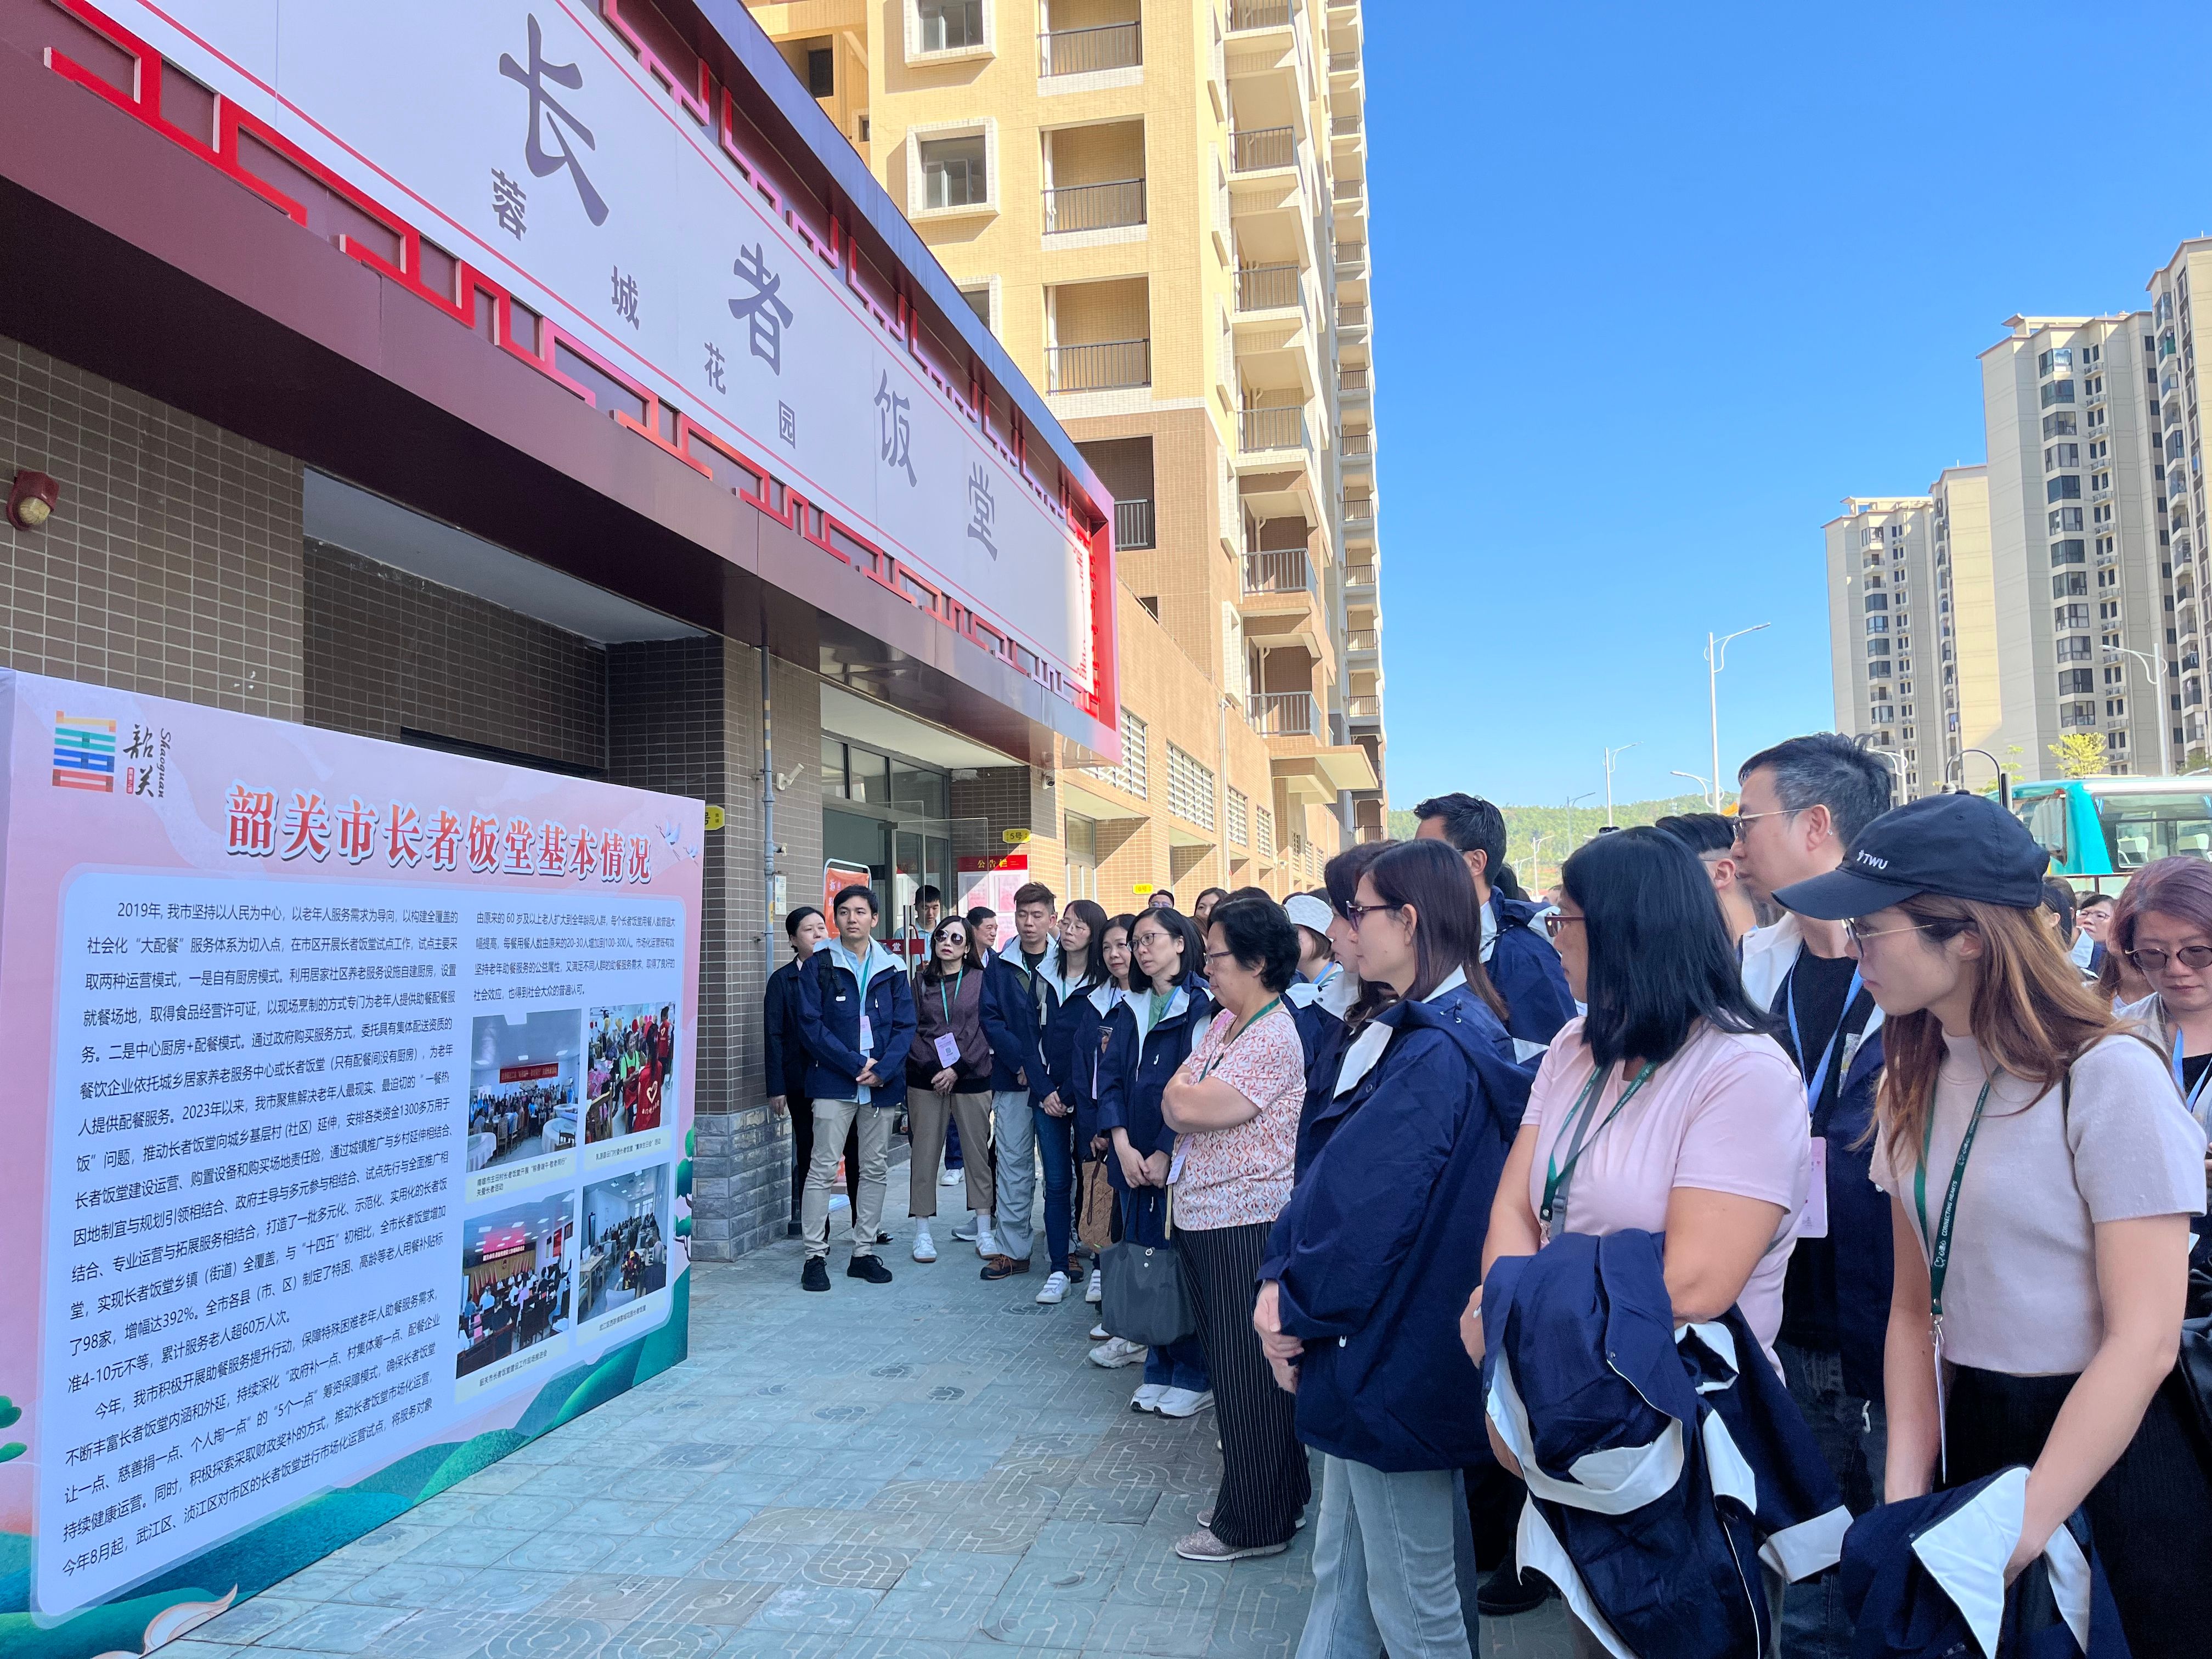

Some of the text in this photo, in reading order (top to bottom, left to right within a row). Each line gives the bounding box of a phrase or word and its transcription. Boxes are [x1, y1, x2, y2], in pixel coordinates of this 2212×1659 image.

[490, 167, 796, 449] 蓉城花园
[499, 13, 998, 562] 长者饭堂
[156, 727, 171, 798] Shaoguan
[225, 783, 652, 882] 韶关市长者饭堂基本情况
[1942, 1180, 1957, 1237] CONNECTING HEARTS
